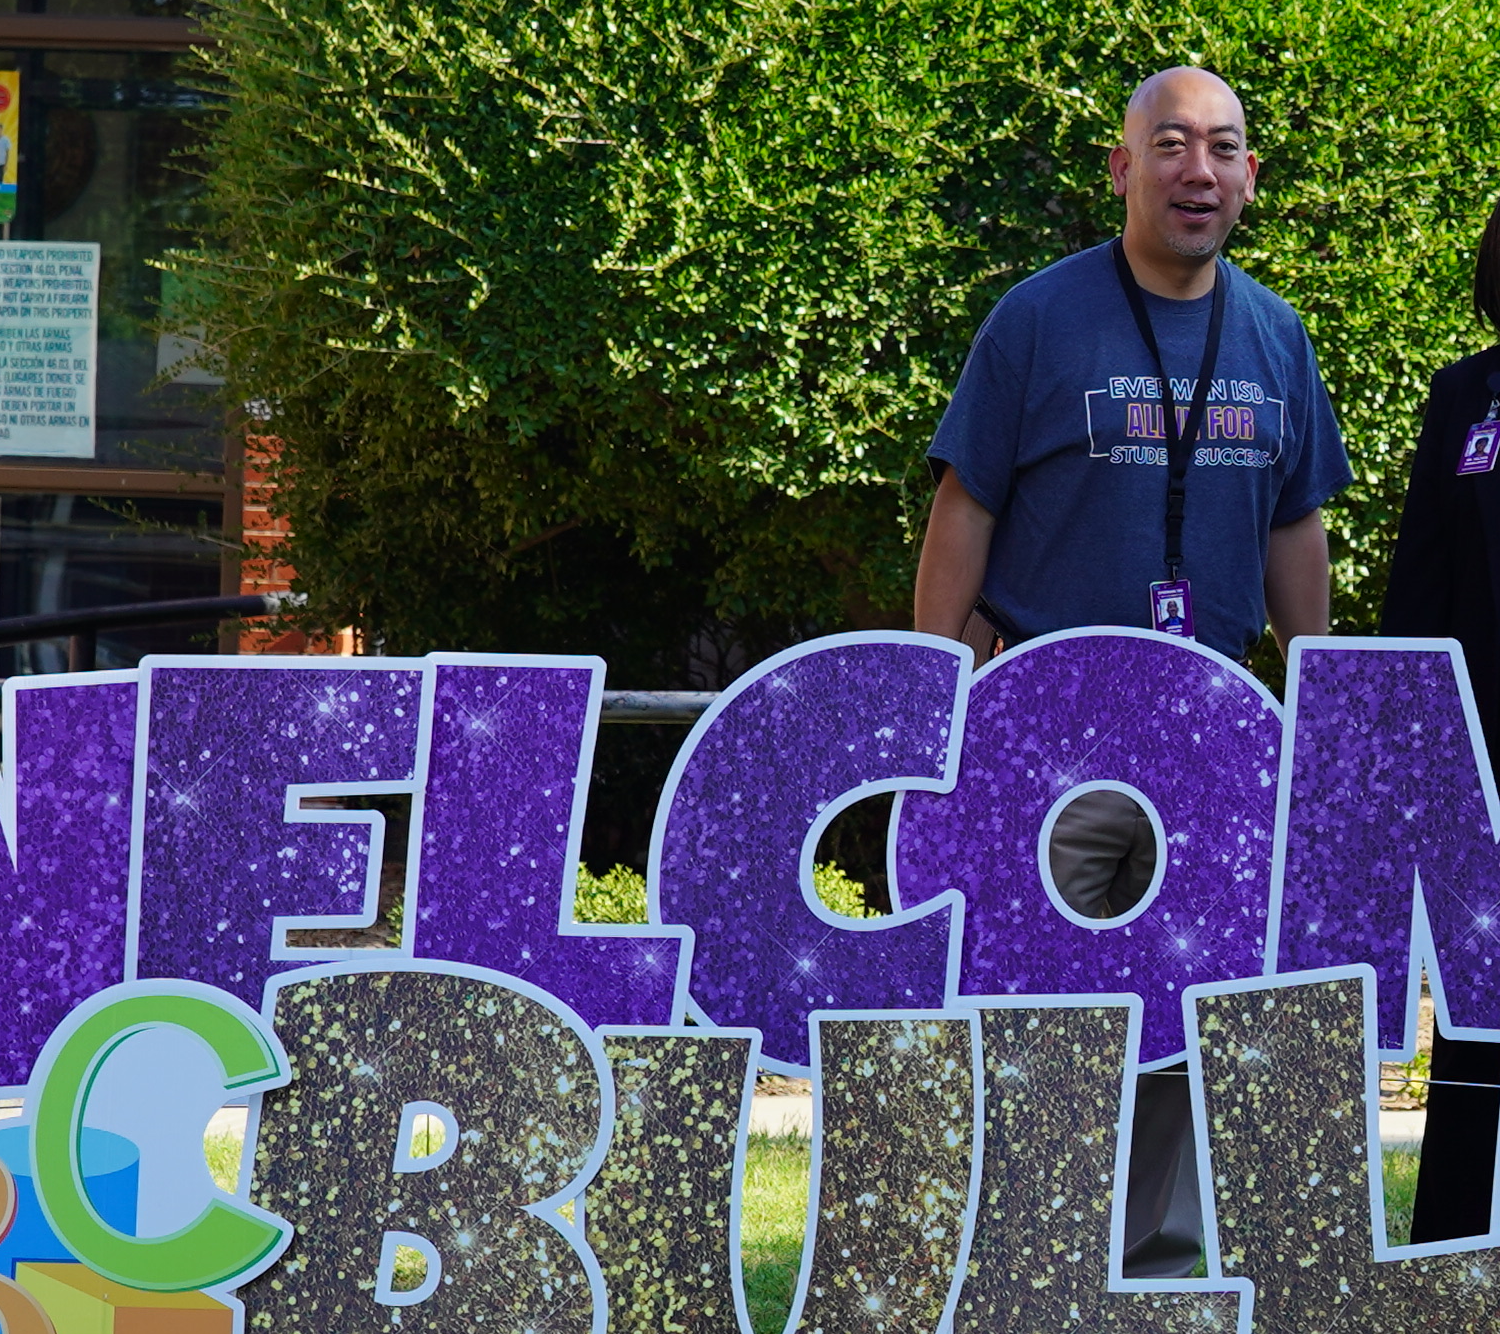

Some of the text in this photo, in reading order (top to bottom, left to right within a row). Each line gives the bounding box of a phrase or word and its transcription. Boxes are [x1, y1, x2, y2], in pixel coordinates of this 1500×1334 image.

[6, 248, 43, 260] WEAPONS
[59, 264, 82, 275] PENAL
[24, 327, 39, 339] LAS
[42, 328, 70, 339] ARMAS
[16, 340, 41, 352] OTRAS
[44, 341, 72, 353] ARMAS
[73, 359, 87, 370] DEL
[3, 385, 30, 397] ARMAS
[1230, 380, 1265, 404] ISD
[1, 400, 27, 411] DEBEN
[64, 401, 75, 412] UN
[20, 414, 45, 426] OTRAS
[48, 415, 76, 426] ARMAS
[1127, 403, 1167, 439] ALL
[1206, 405, 1255, 440] FOR
[1110, 446, 1271, 468] STUDE SUCCESS
